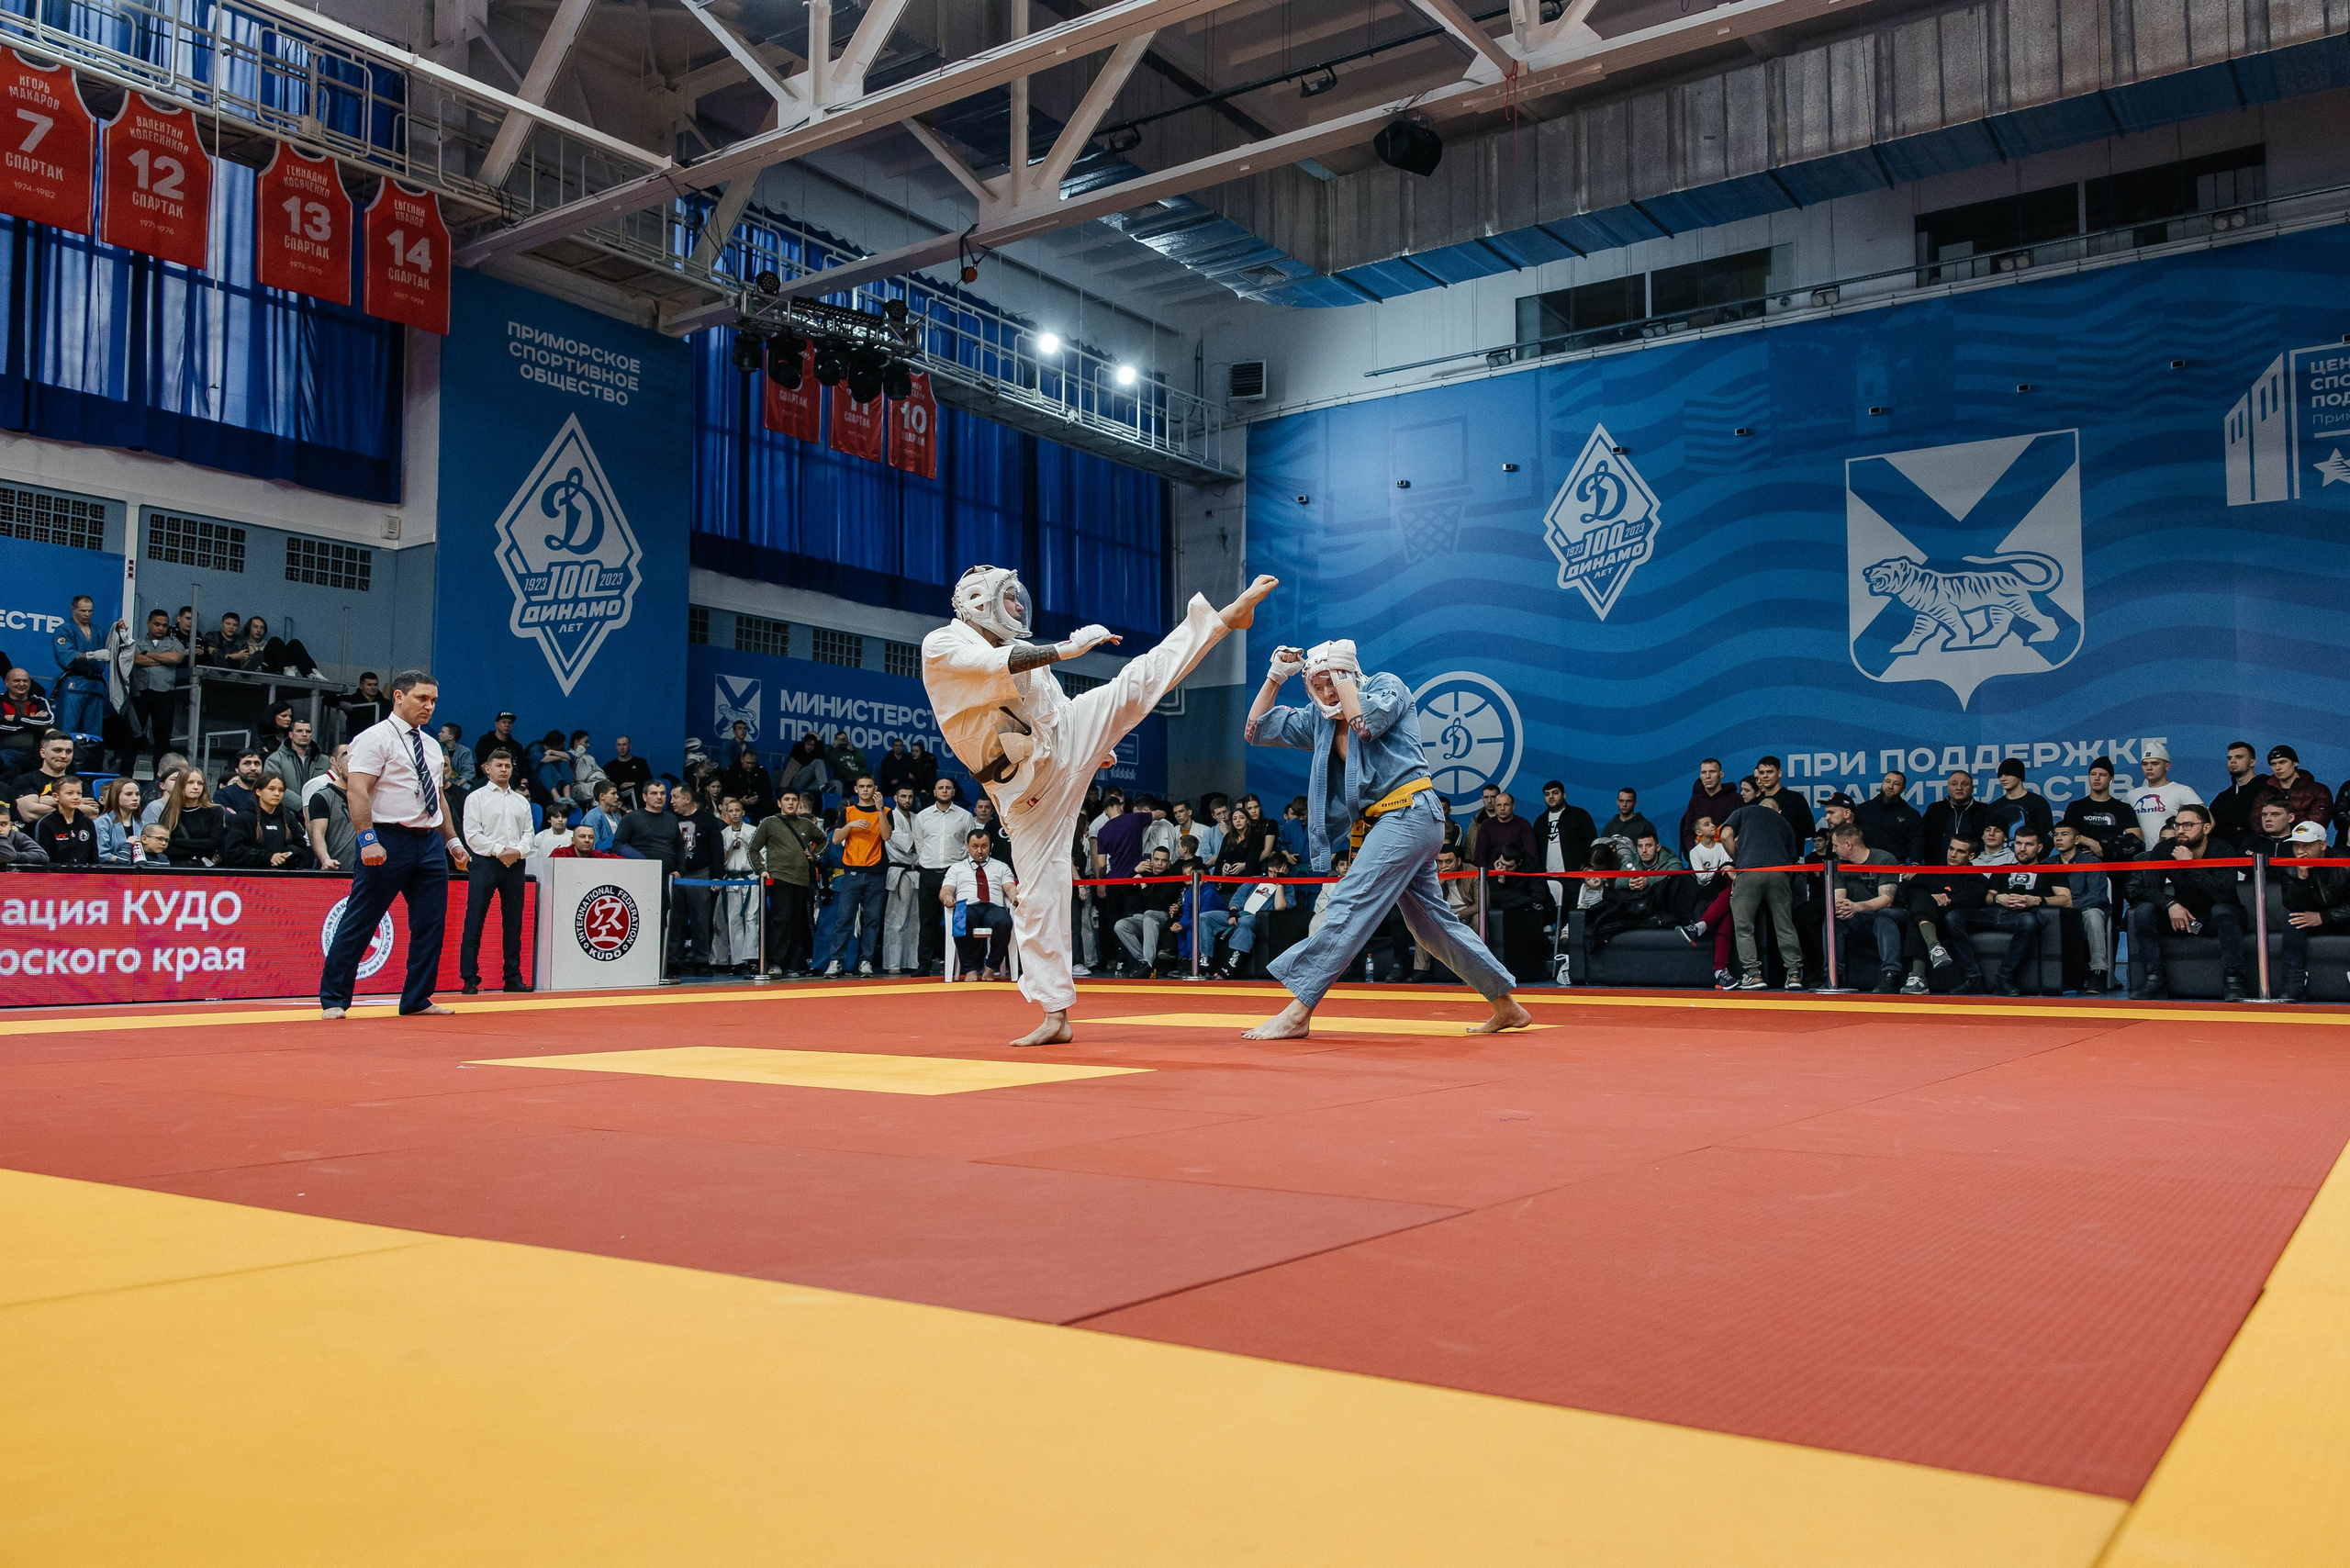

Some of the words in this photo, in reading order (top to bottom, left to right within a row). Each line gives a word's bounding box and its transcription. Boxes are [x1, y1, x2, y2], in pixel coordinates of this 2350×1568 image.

[8, 85, 61, 110] МАКАРОВ
[19, 75, 50, 94] ИГОРЬ
[17, 107, 54, 154] 7
[136, 115, 184, 140] ВАЛЕНТИН
[6, 151, 64, 182] СПАРТАК
[129, 148, 185, 201] 12
[132, 191, 184, 219] СПАРТАК
[282, 196, 331, 241] 13
[284, 234, 330, 260] СПАРТАК
[386, 229, 432, 274] 14
[388, 267, 431, 291] СПАРТАК
[508, 320, 641, 375] ПРИМОРСКОЕ
[509, 342, 640, 392] СПОРТИВНОЕ
[520, 364, 630, 407] ОБЩЕСТВО
[901, 400, 927, 434] 10
[1566, 543, 1584, 558] 1923
[1583, 522, 1626, 558] 100
[1625, 522, 1646, 538] 2023
[1566, 543, 1645, 579] ДИНАМО
[1594, 567, 1614, 579] ЛЕТ
[524, 577, 548, 592] 1923
[548, 564, 602, 601] 100
[599, 573, 624, 587] 2023
[521, 599, 622, 624] ДИНАМО
[558, 622, 584, 633] ЛЕТ
[1787, 751, 1866, 778] ПРИ
[122, 889, 242, 932] КУДО
[576, 886, 615, 944] INTERNATIONAL
[617, 890, 639, 946] FEDERATION
[152, 946, 246, 982] края
